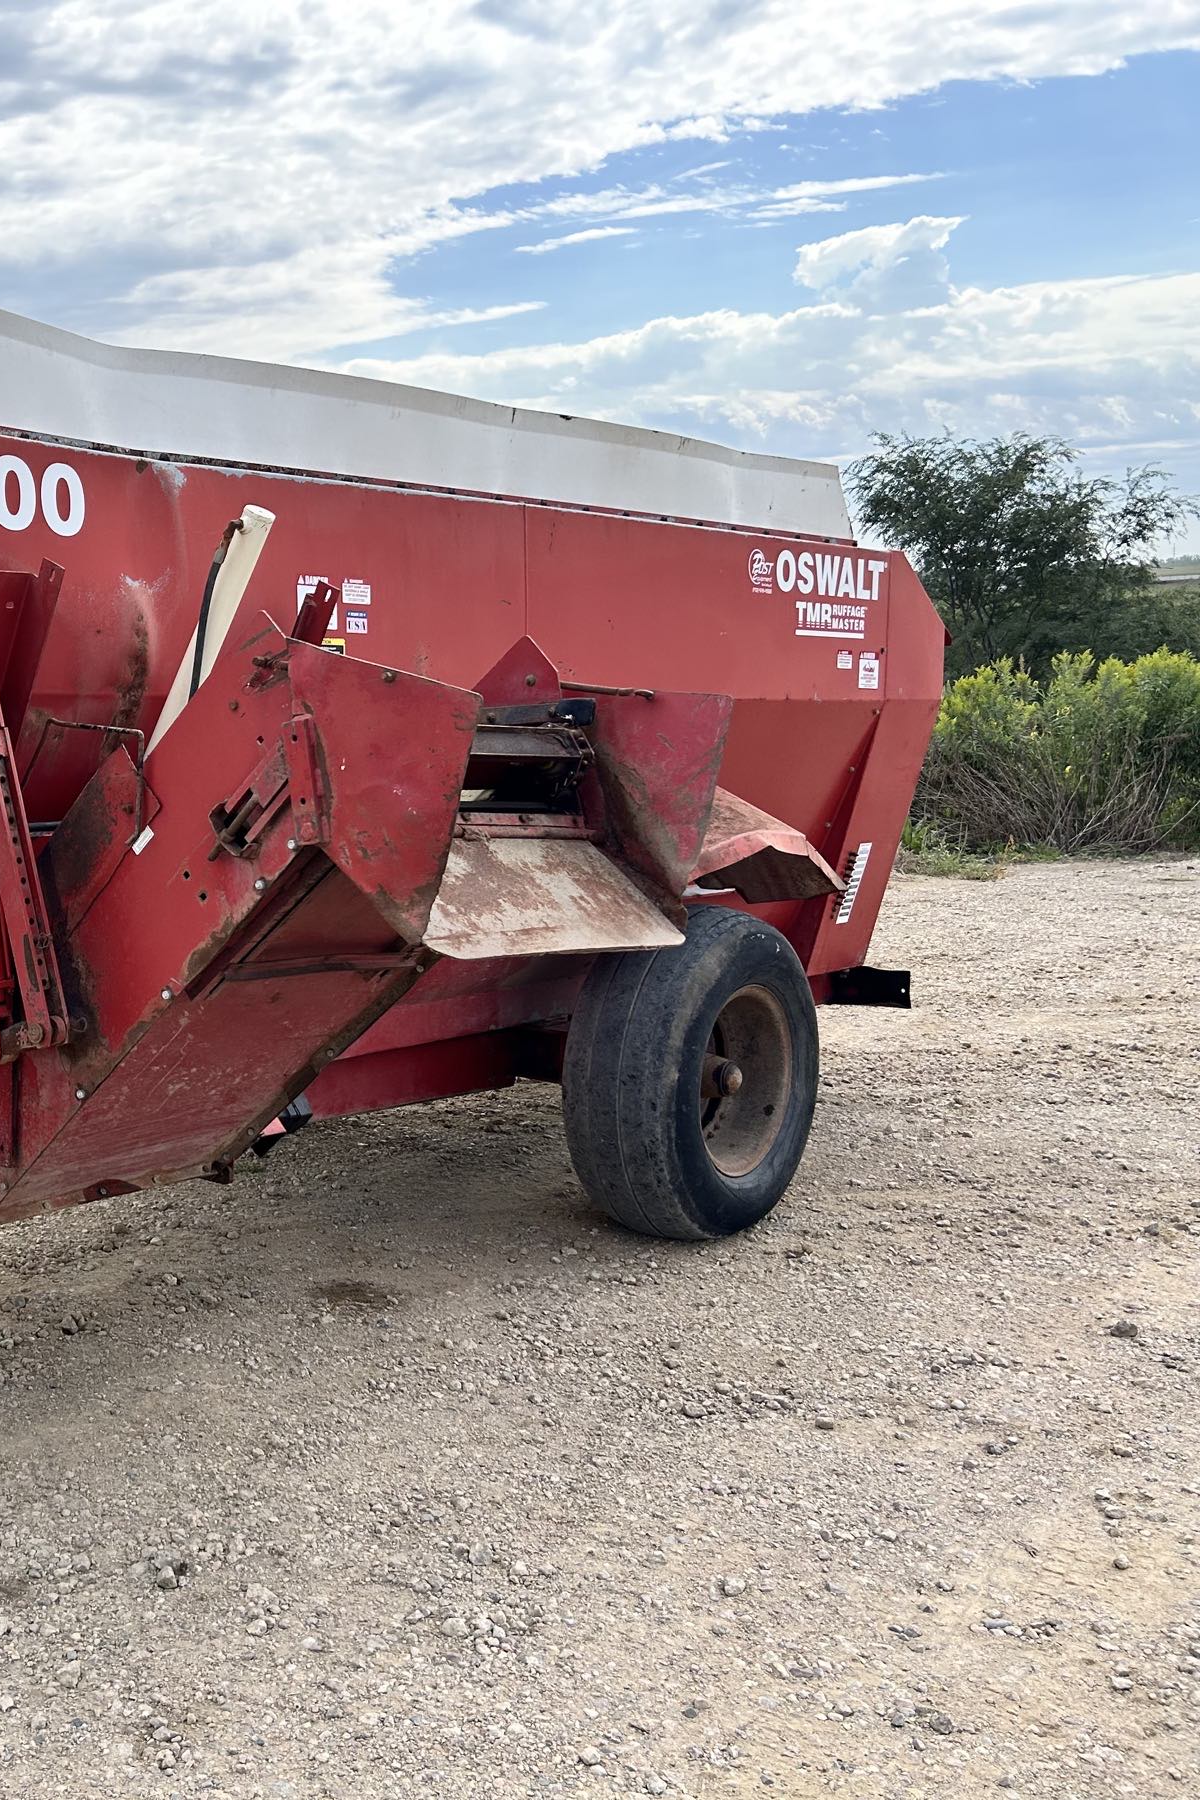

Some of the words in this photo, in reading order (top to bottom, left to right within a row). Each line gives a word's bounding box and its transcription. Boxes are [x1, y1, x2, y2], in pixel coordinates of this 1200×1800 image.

[776, 549, 885, 600] OSWALT
[795, 601, 832, 628] TMR
[832, 604, 866, 618] RUFFAGE
[348, 620, 366, 631] USA
[832, 617, 864, 631] MASTER
